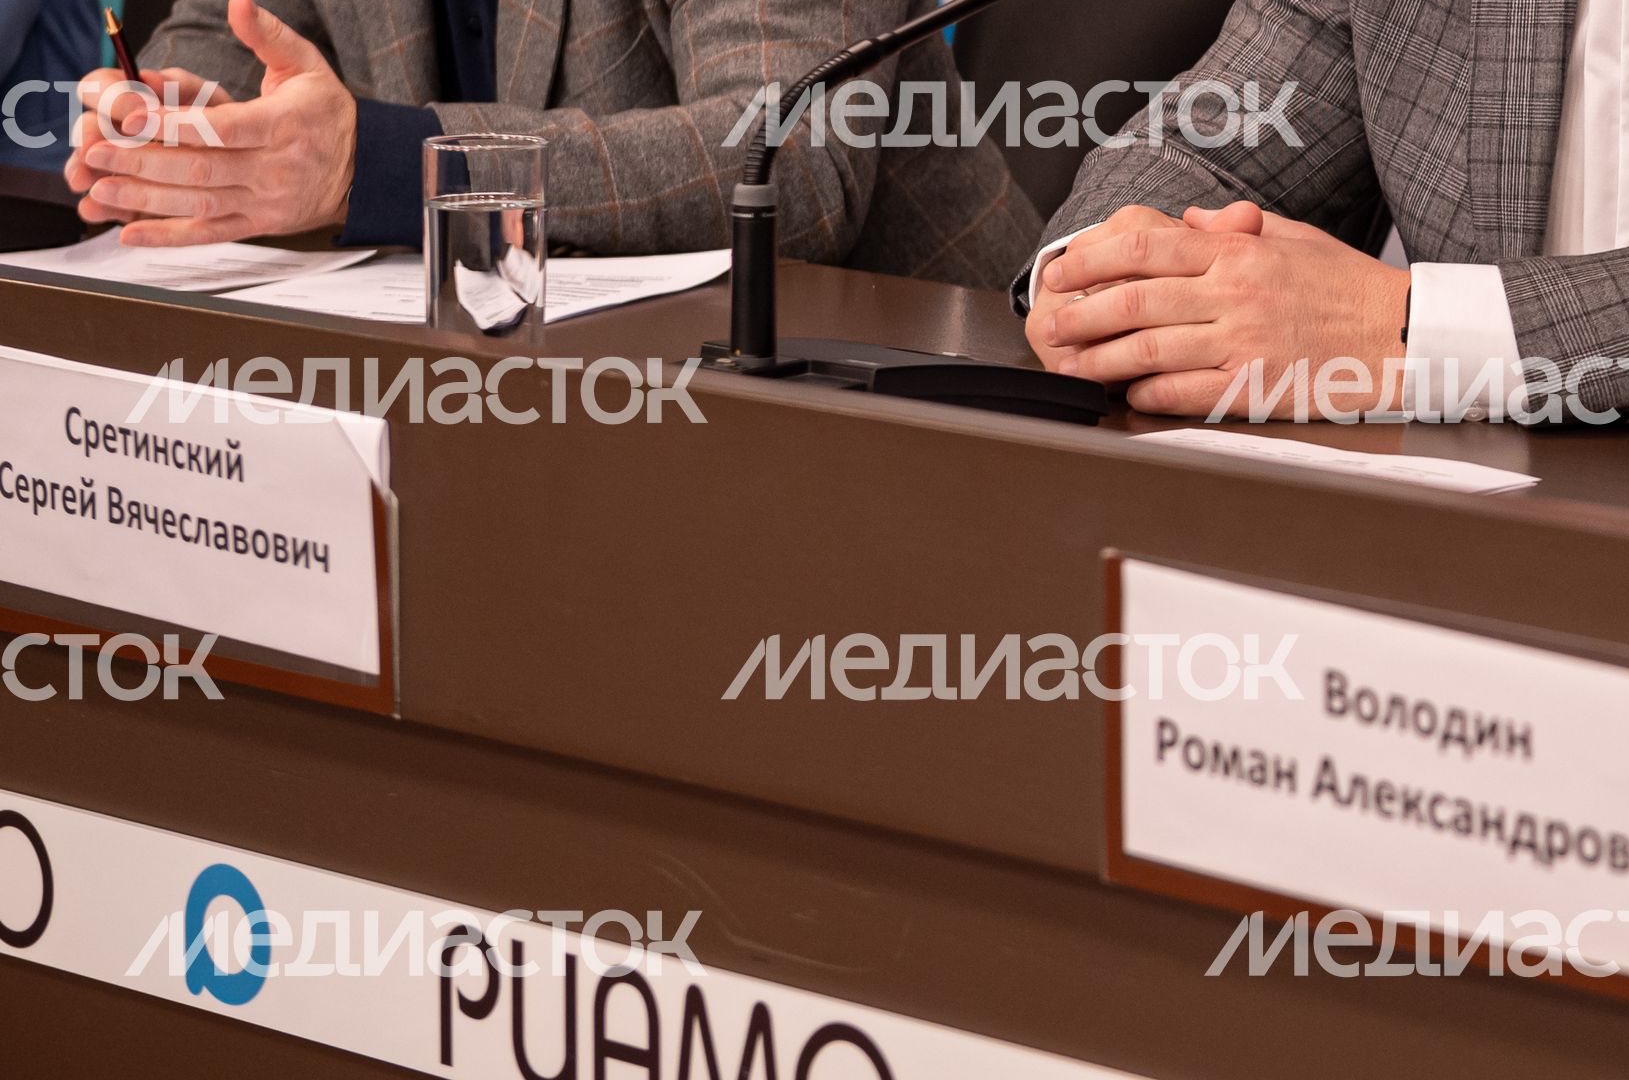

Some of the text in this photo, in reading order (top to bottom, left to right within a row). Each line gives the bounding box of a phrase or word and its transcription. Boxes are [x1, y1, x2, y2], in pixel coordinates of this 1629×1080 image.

[65, 406, 245, 483] Сретинский
[0, 461, 331, 574] Сергей Вячеславович
[1155, 719, 1298, 794] Роман
[1324, 669, 1534, 760] Володин
